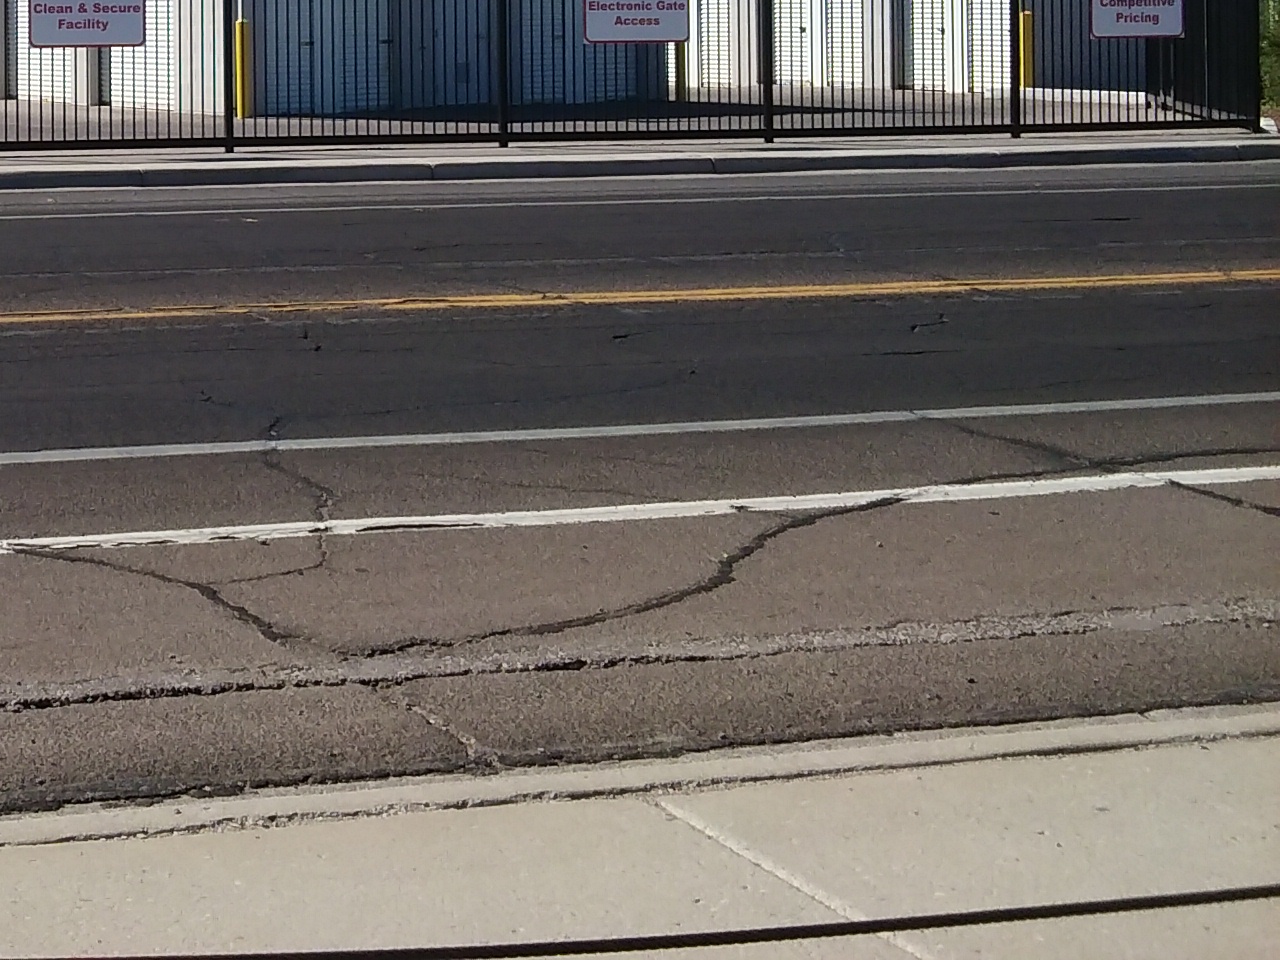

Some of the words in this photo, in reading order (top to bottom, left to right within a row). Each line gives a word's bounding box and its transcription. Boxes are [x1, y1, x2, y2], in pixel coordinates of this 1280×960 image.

[33, 3, 73, 14] Clean
[77, 2, 88, 14] &
[92, 2, 141, 14] Secure
[588, 0, 652, 12] Electronic
[656, 0, 686, 12] Gate
[614, 15, 660, 26] Access
[1116, 11, 1160, 25] Pricing
[58, 18, 109, 32] Facility
